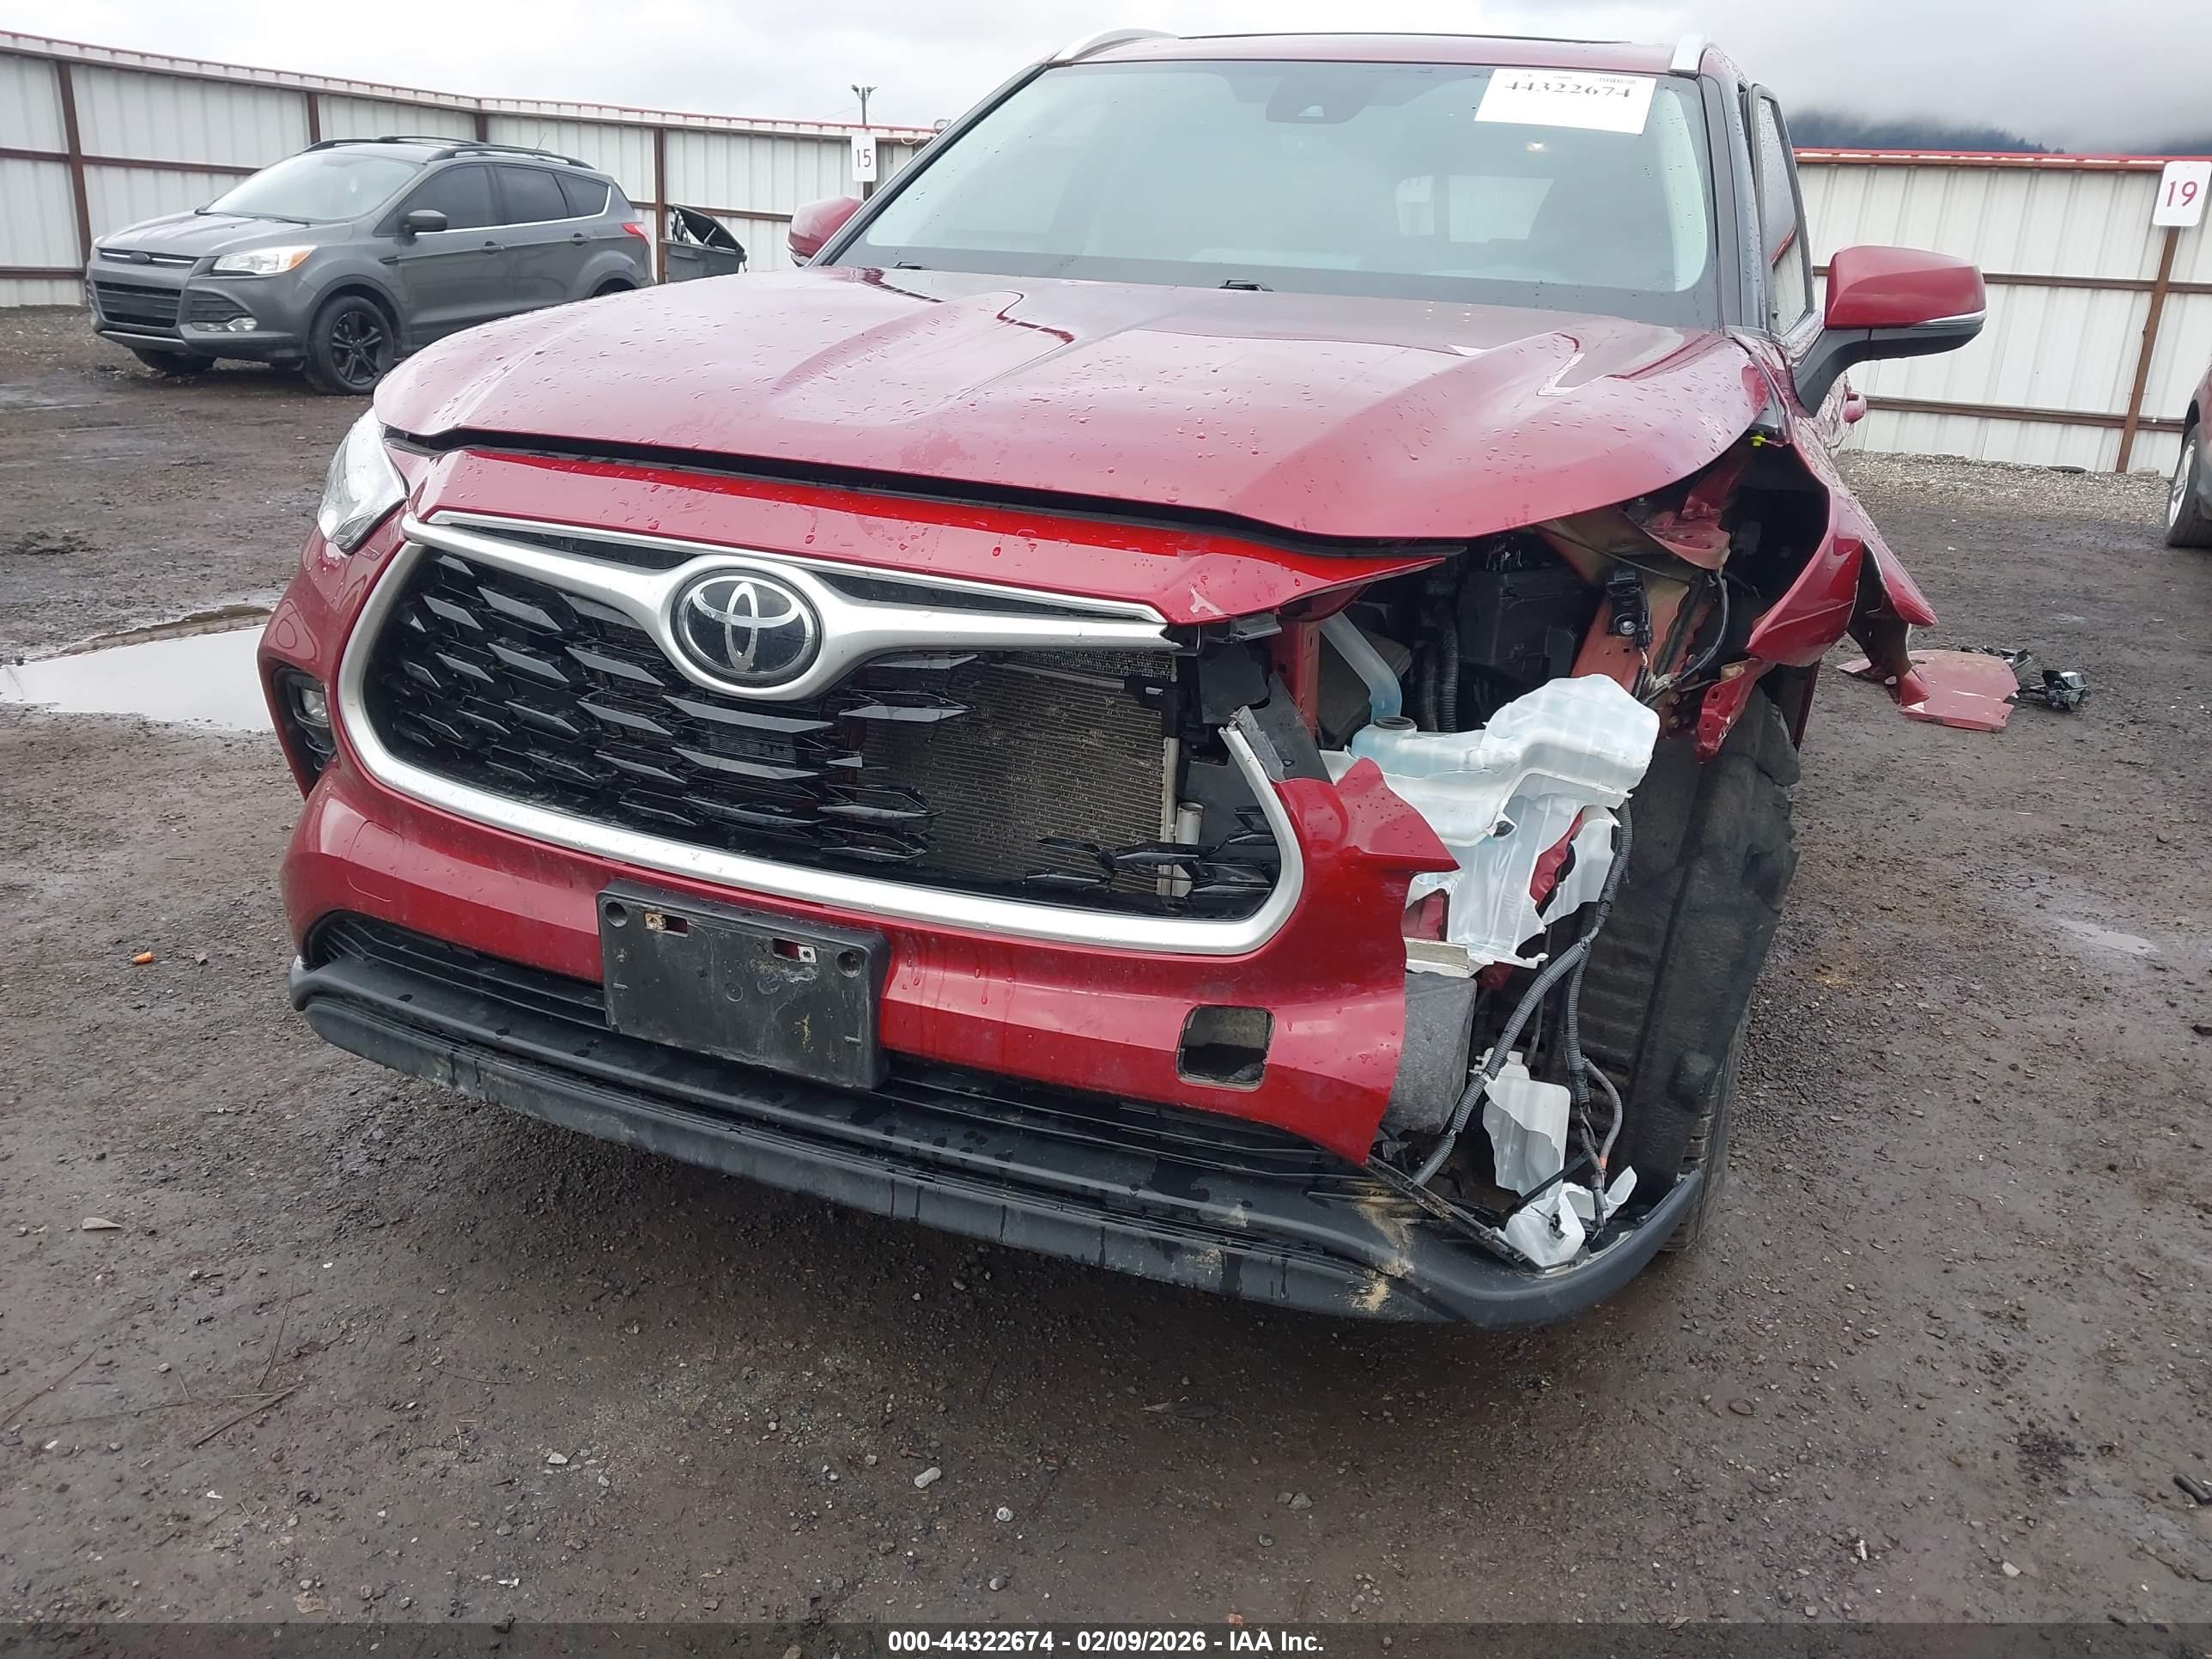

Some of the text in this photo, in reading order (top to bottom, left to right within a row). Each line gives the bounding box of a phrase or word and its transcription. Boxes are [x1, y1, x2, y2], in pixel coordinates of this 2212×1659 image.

[1504, 81, 1632, 98] 44322674
[856, 148, 872, 168] 15
[2166, 180, 2198, 208] 19
